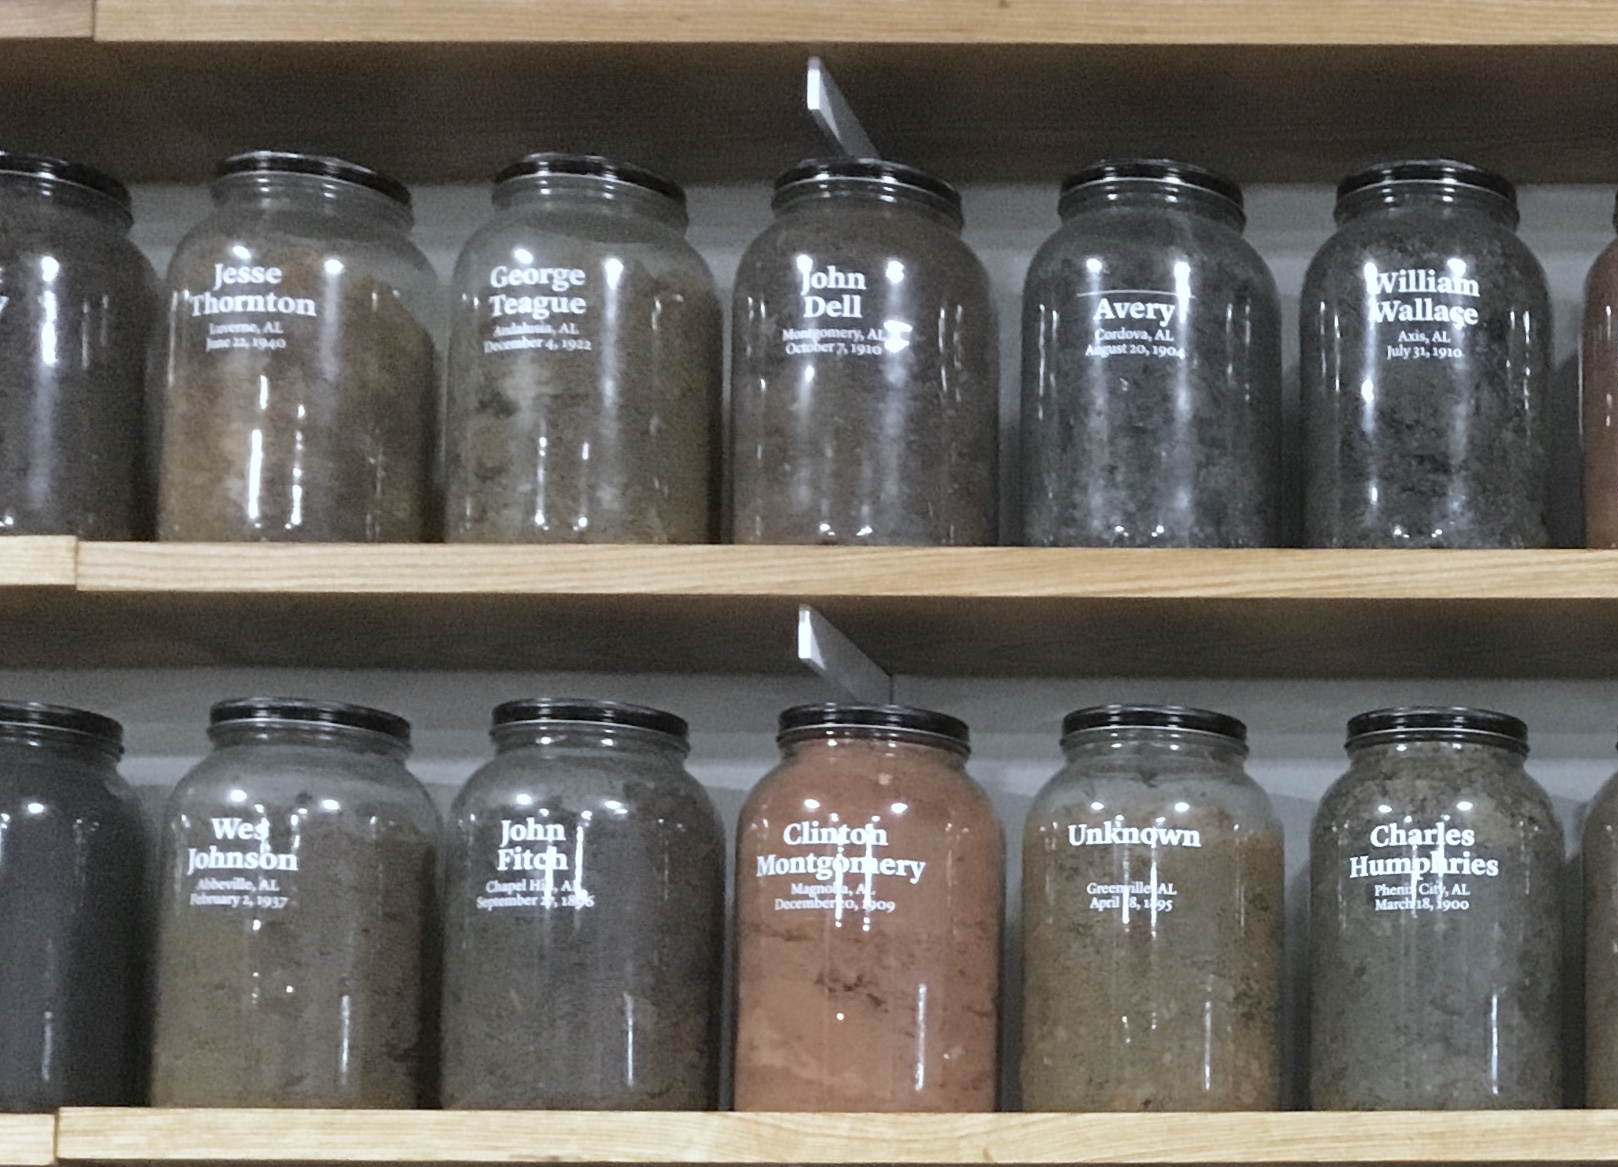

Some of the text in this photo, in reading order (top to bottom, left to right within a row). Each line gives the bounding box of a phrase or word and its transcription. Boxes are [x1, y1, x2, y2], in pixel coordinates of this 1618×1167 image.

[214, 263, 282, 291] Jesse
[490, 266, 586, 292] George
[800, 266, 867, 296] John
[1372, 269, 1480, 297] William
[191, 292, 317, 317] Thornton
[490, 295, 586, 320] Teague
[804, 295, 862, 319] Dell
[1093, 299, 1176, 327] Avery
[1398, 330, 1451, 344] Axis, AL
[1387, 344, 1462, 360] July 31, 1910
[501, 818, 566, 847] John
[783, 820, 888, 846] Clinton
[1068, 821, 1201, 847] Unknown
[1370, 823, 1475, 847] Charles
[187, 846, 298, 874] Johnson
[498, 846, 568, 871] Fitch
[756, 853, 926, 884] Montgomery
[1350, 851, 1499, 879] Humphries
